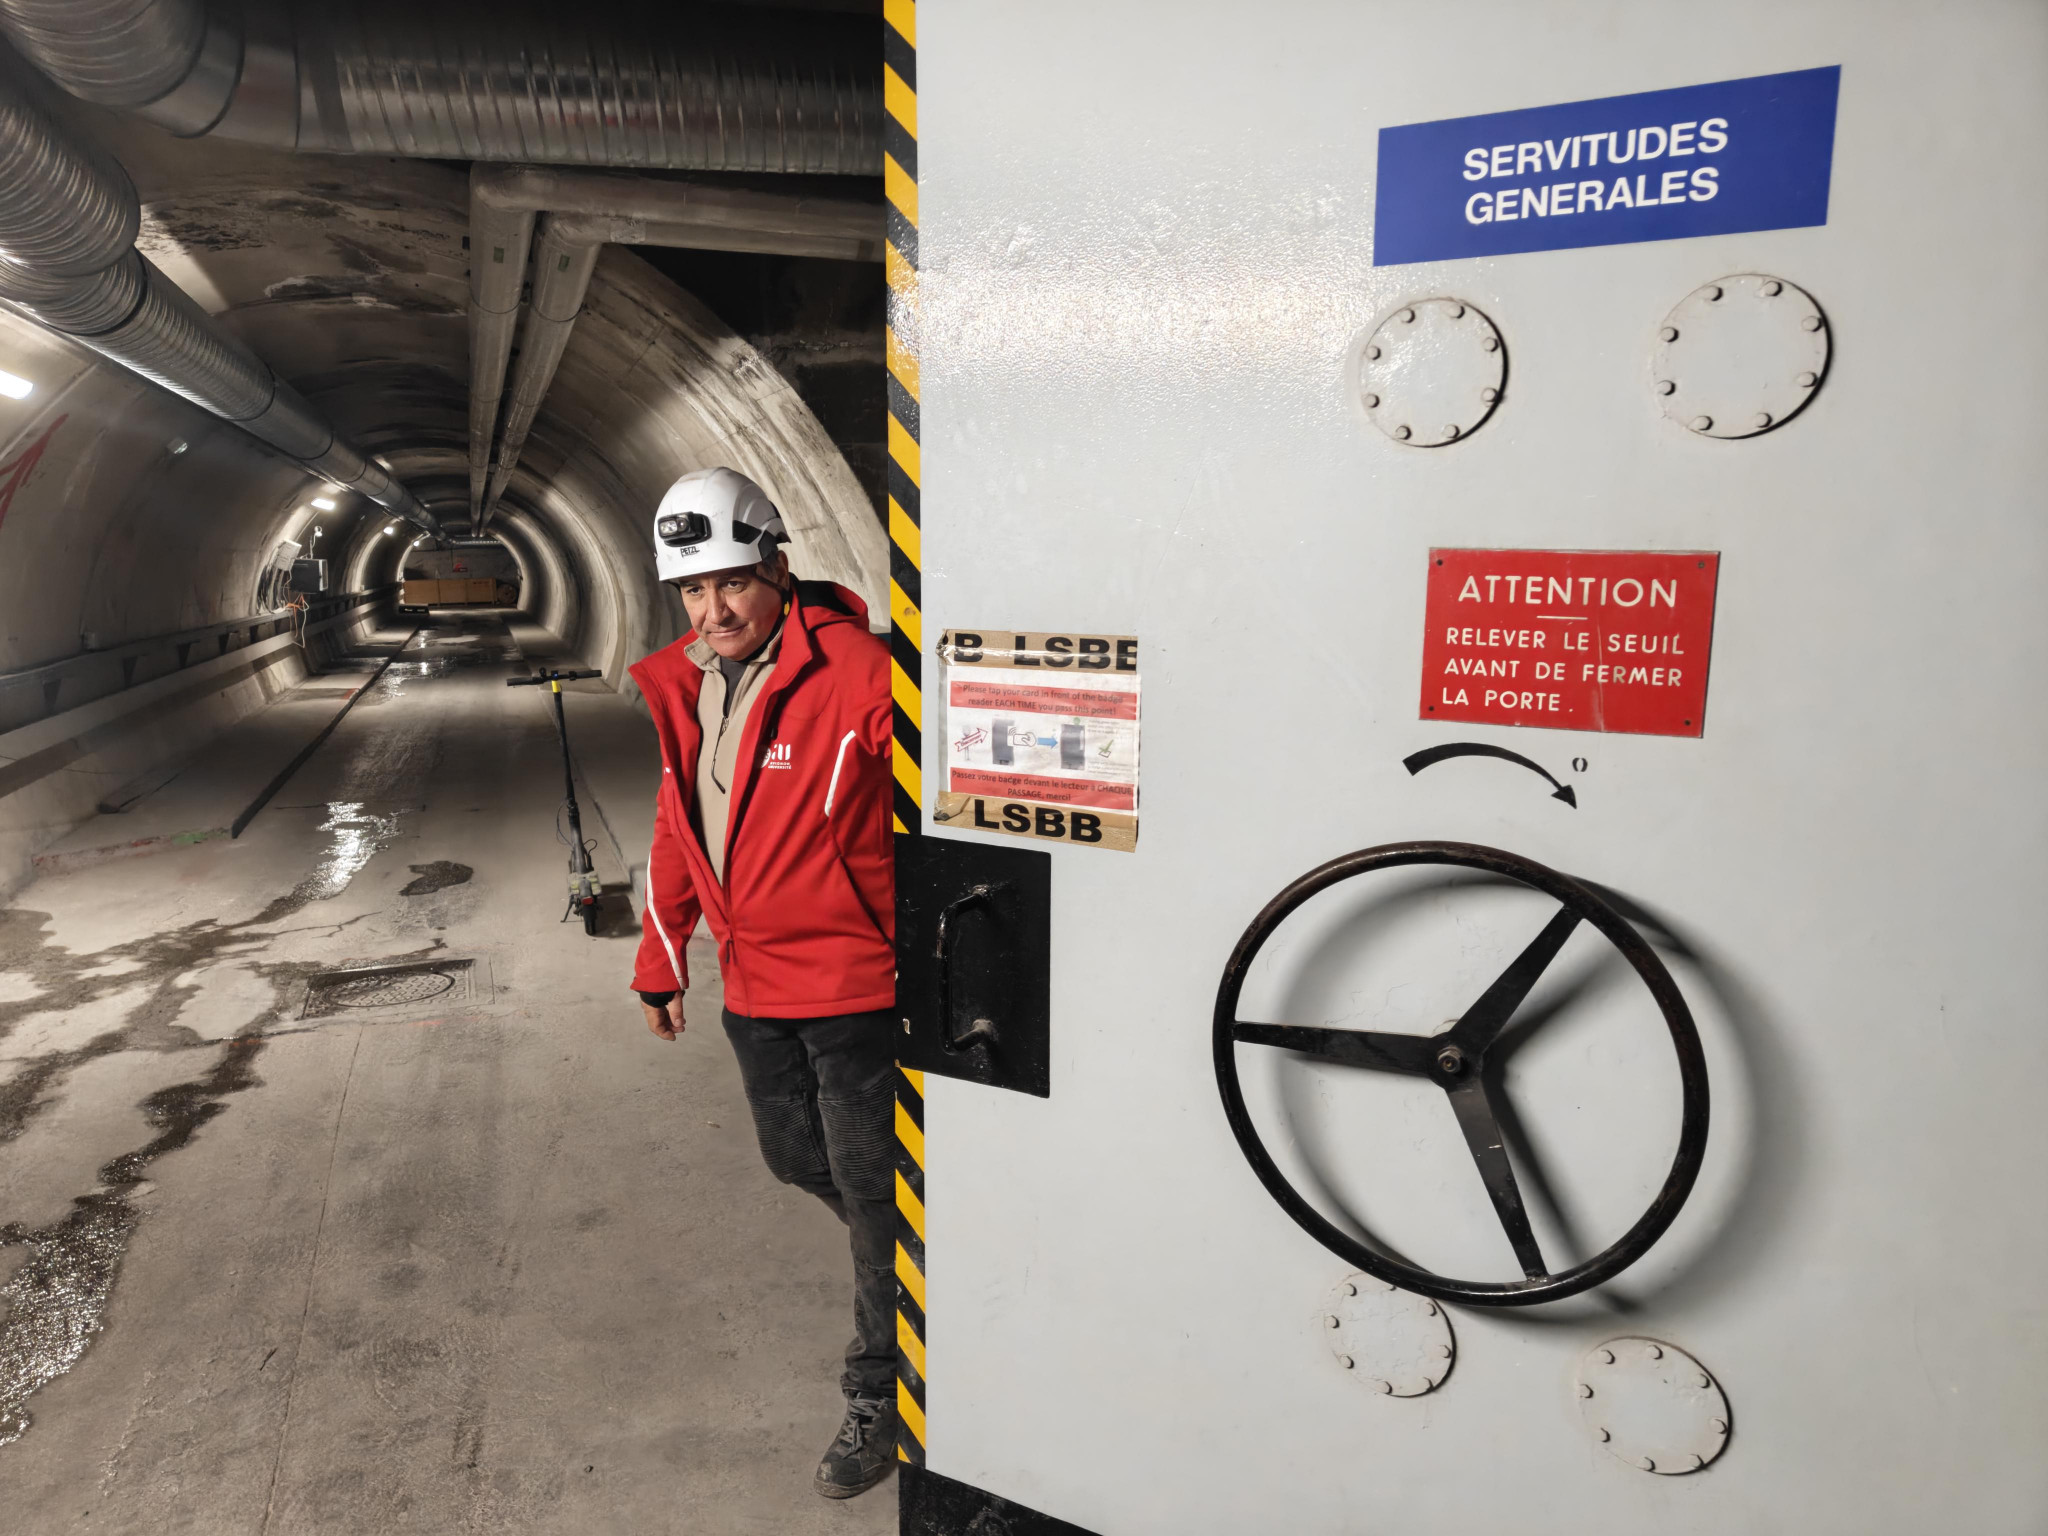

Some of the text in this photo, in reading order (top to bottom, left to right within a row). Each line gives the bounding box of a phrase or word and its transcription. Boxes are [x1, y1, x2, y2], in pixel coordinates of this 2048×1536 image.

[1462, 117, 1729, 181] SERVITUDES
[1464, 166, 1720, 225] GENERALES
[680, 546, 700, 558] PETZL
[1458, 574, 1678, 608] ATTENTION
[1446, 627, 1685, 655] RELEVER LE SEUIL
[1444, 658, 1683, 687] AVANT DE FERMER
[963, 684, 1123, 704] Please tap your card in front of the badge
[968, 698, 1116, 716] reader EACH TIME you pass this point!
[1442, 687, 1470, 706] LA
[952, 770, 976, 780] Passez
[977, 773, 997, 783] votre
[998, 775, 1022, 786] badge
[1023, 777, 1050, 788] devant
[1052, 779, 1059, 789] le
[1061, 780, 1088, 792] lecteur
[1097, 783, 1133, 796] CHAQUE
[974, 799, 1103, 843] LSBB
